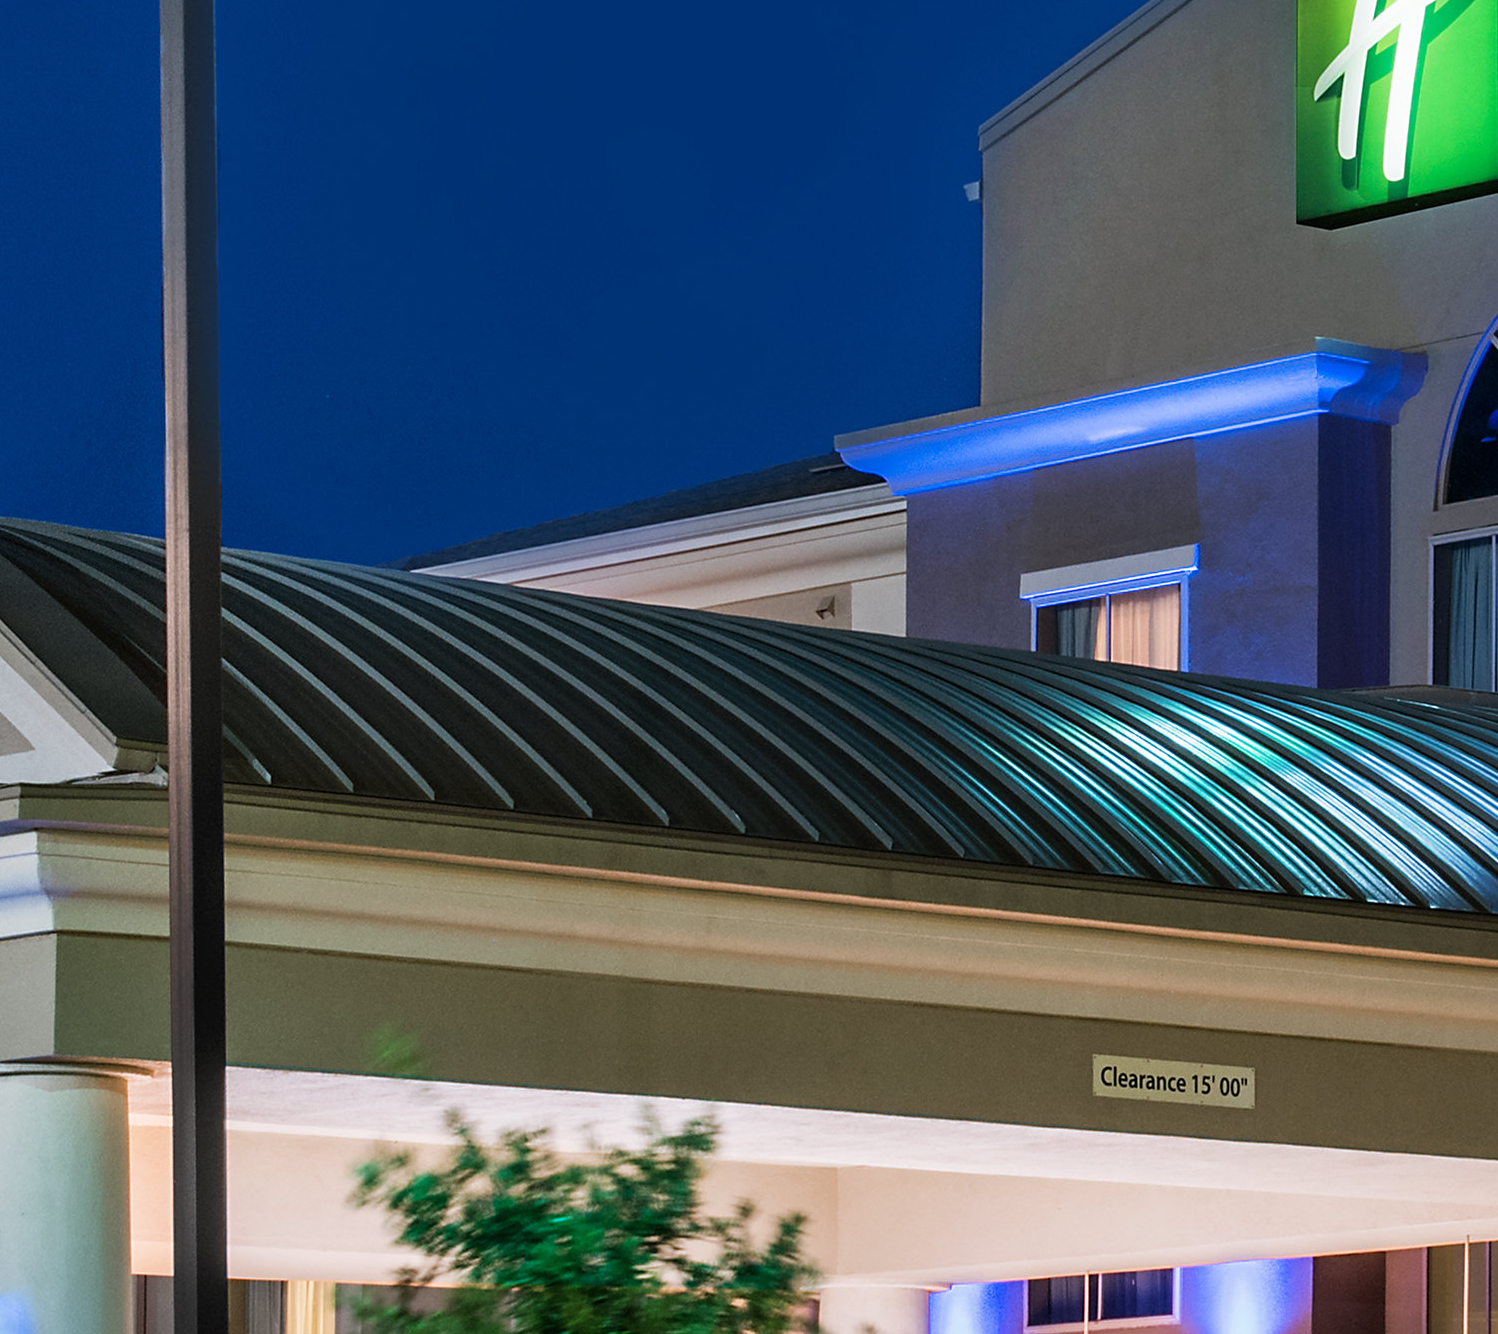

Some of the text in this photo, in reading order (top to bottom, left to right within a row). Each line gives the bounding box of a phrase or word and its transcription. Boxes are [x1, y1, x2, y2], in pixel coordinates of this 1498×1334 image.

[1100, 1066, 1248, 1097] Clearance 15' 00"
